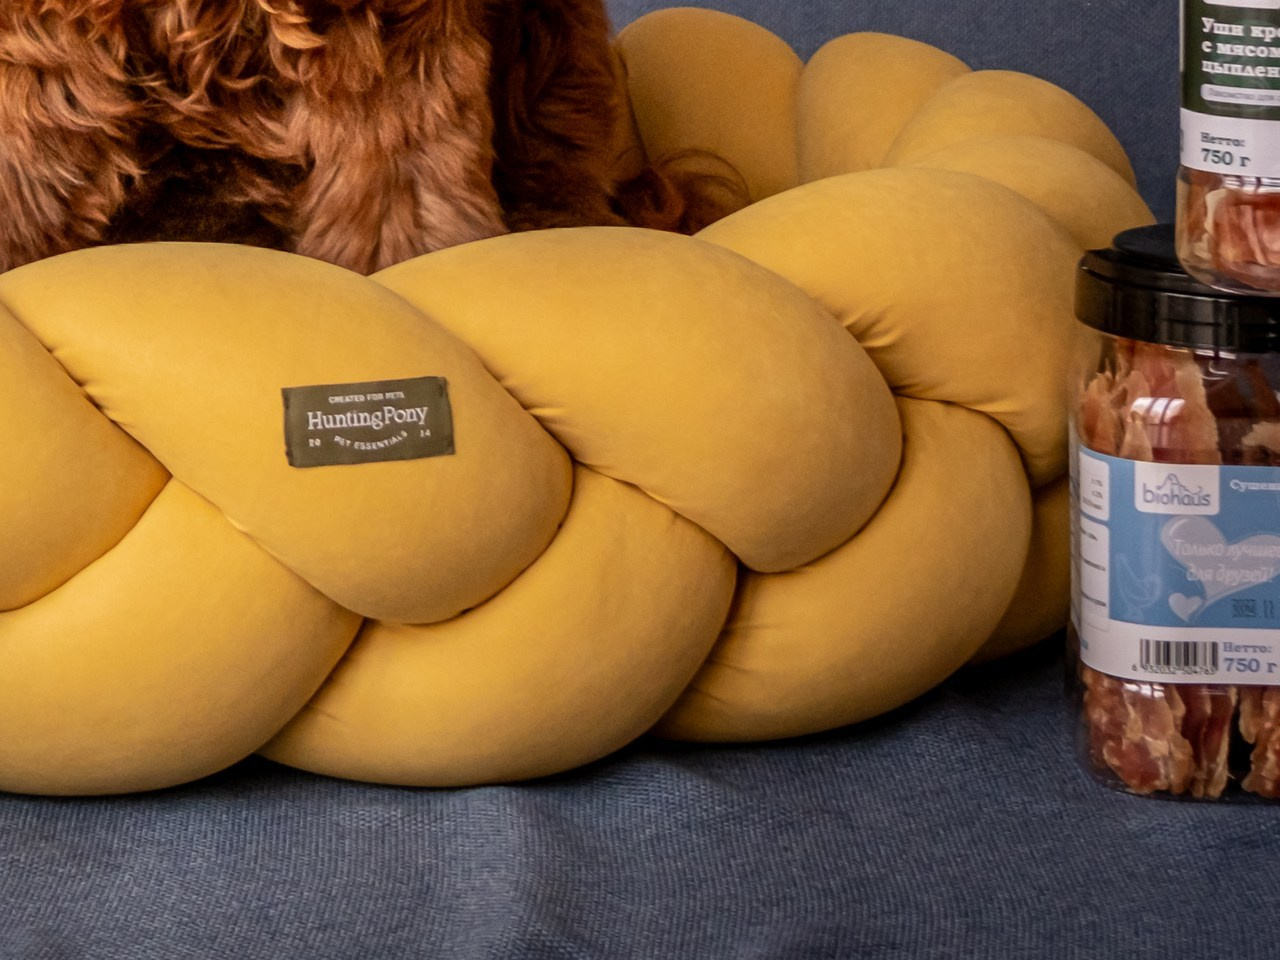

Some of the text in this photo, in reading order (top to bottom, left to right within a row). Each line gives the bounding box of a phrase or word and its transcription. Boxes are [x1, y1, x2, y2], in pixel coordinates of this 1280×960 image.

[1201, 16, 1244, 37] Уши
[1201, 41, 1212, 52] с
[1201, 148, 1251, 167] 750 г
[328, 394, 365, 404] CREATED
[366, 392, 384, 401] FOR
[354, 430, 408, 450] ESSENTIALS
[1143, 483, 1210, 506] biohaus
[1223, 642, 1272, 653] Нетто:
[1223, 657, 1278, 673] 750 г
